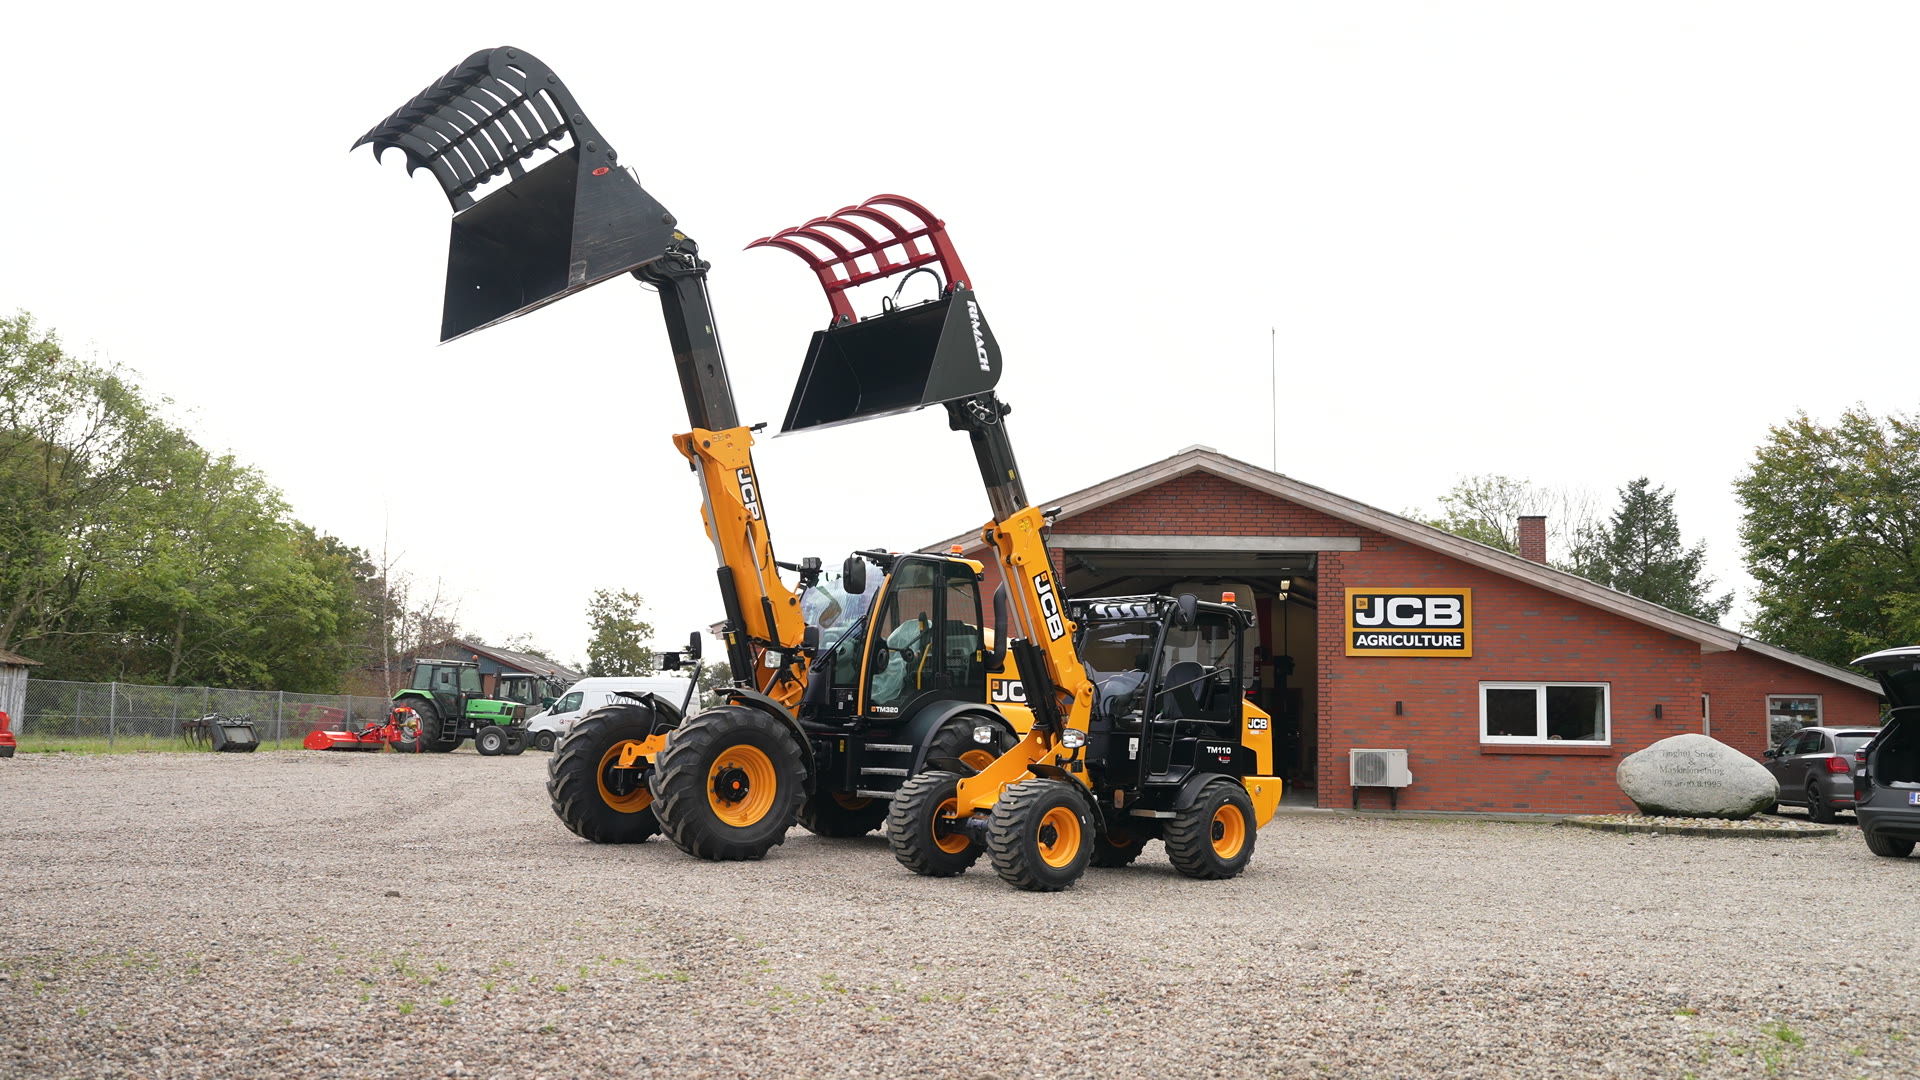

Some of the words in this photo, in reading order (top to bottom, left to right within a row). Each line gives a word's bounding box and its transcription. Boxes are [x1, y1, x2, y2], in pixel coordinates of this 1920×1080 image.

[737, 468, 760, 520] JCB
[1034, 574, 1064, 640] JCB
[1355, 597, 1462, 626] JCB
[1356, 634, 1462, 647] AGRICULTURE
[992, 680, 1027, 702] JC
[1248, 718, 1267, 729] JCB
[1206, 746, 1232, 754] TM110
